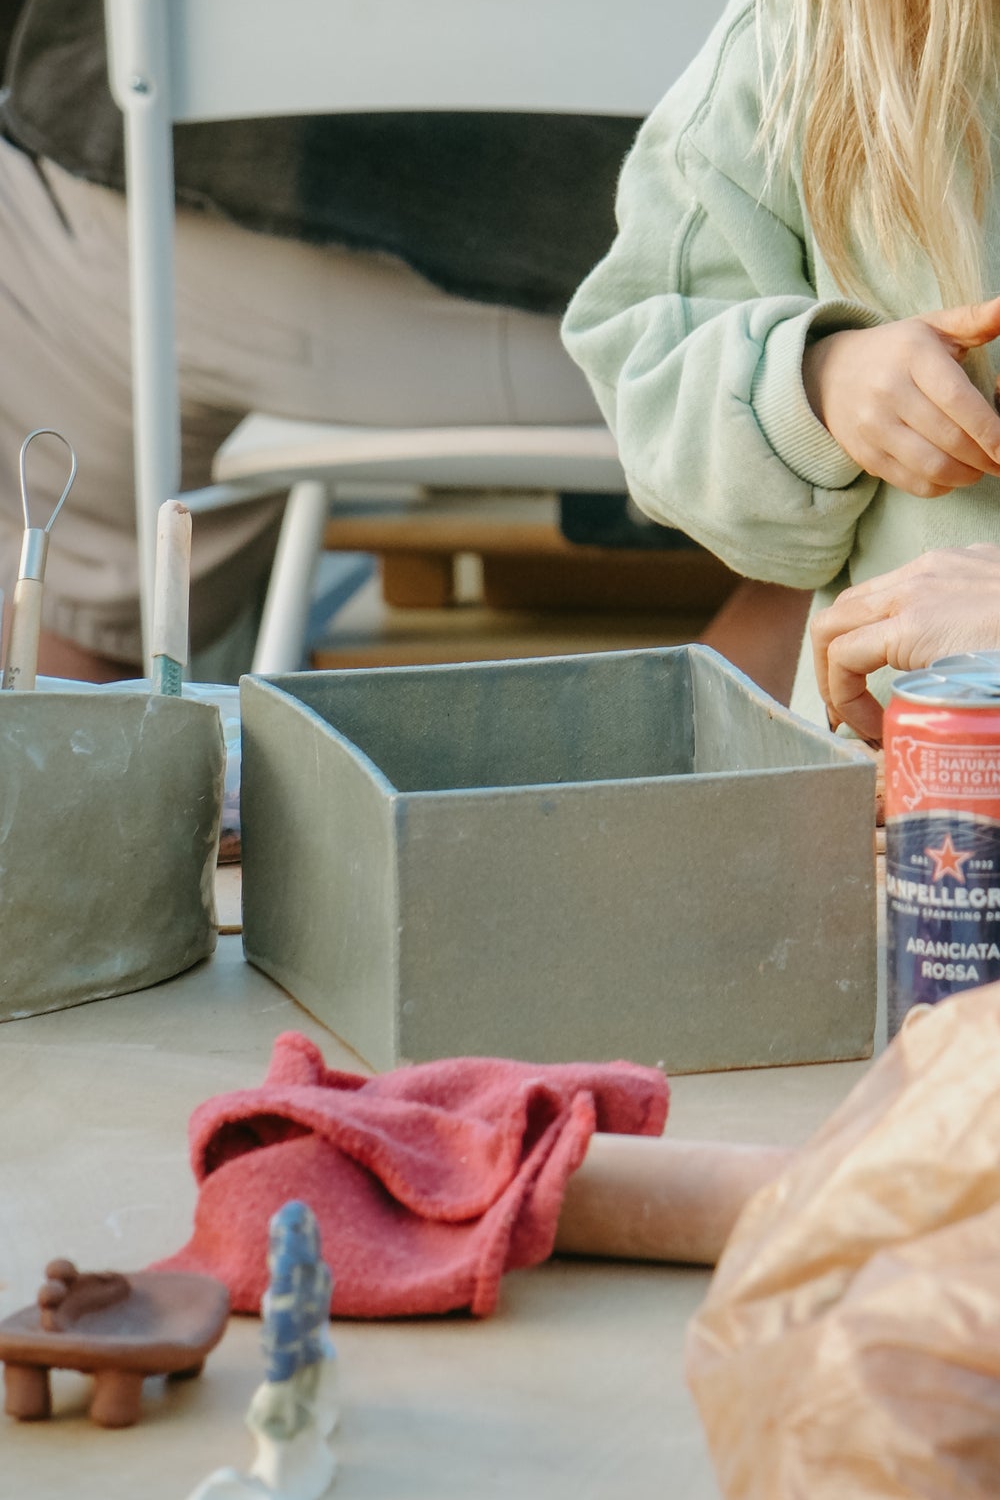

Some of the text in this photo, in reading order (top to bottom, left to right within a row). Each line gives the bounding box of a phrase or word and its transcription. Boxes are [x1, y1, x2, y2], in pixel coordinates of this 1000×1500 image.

[922, 908, 981, 922] SPARKLING
[906, 936, 1000, 960] ARANCIATA
[921, 960, 979, 982] ROSSA
